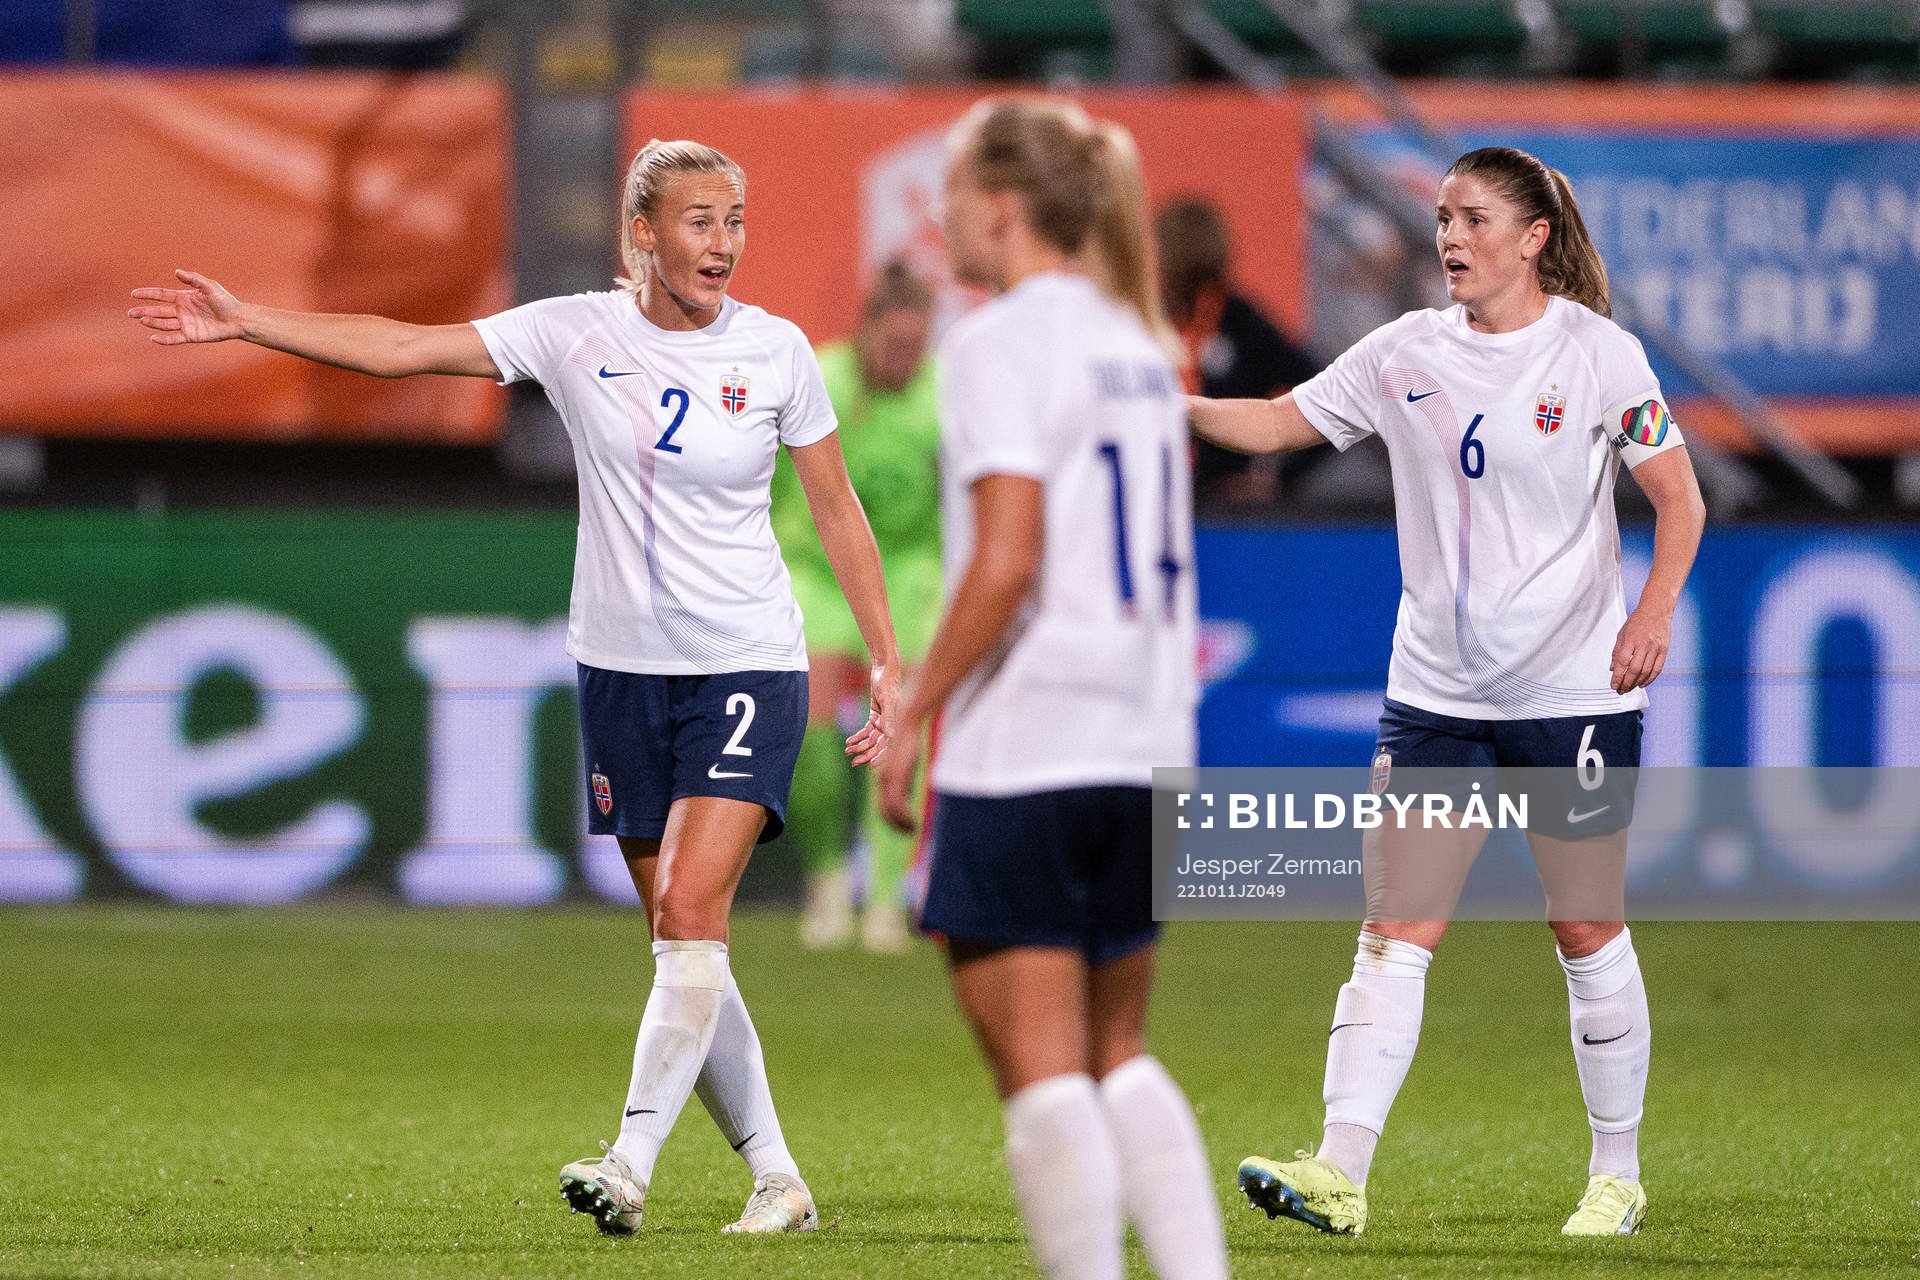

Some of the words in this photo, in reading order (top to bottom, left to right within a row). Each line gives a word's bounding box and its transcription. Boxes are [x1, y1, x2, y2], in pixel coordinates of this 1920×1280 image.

[654, 387, 690, 455] 2
[1460, 413, 1485, 479] 6
[1097, 440, 1181, 622] 14
[721, 692, 756, 757] 2
[1576, 724, 1605, 791] 6
